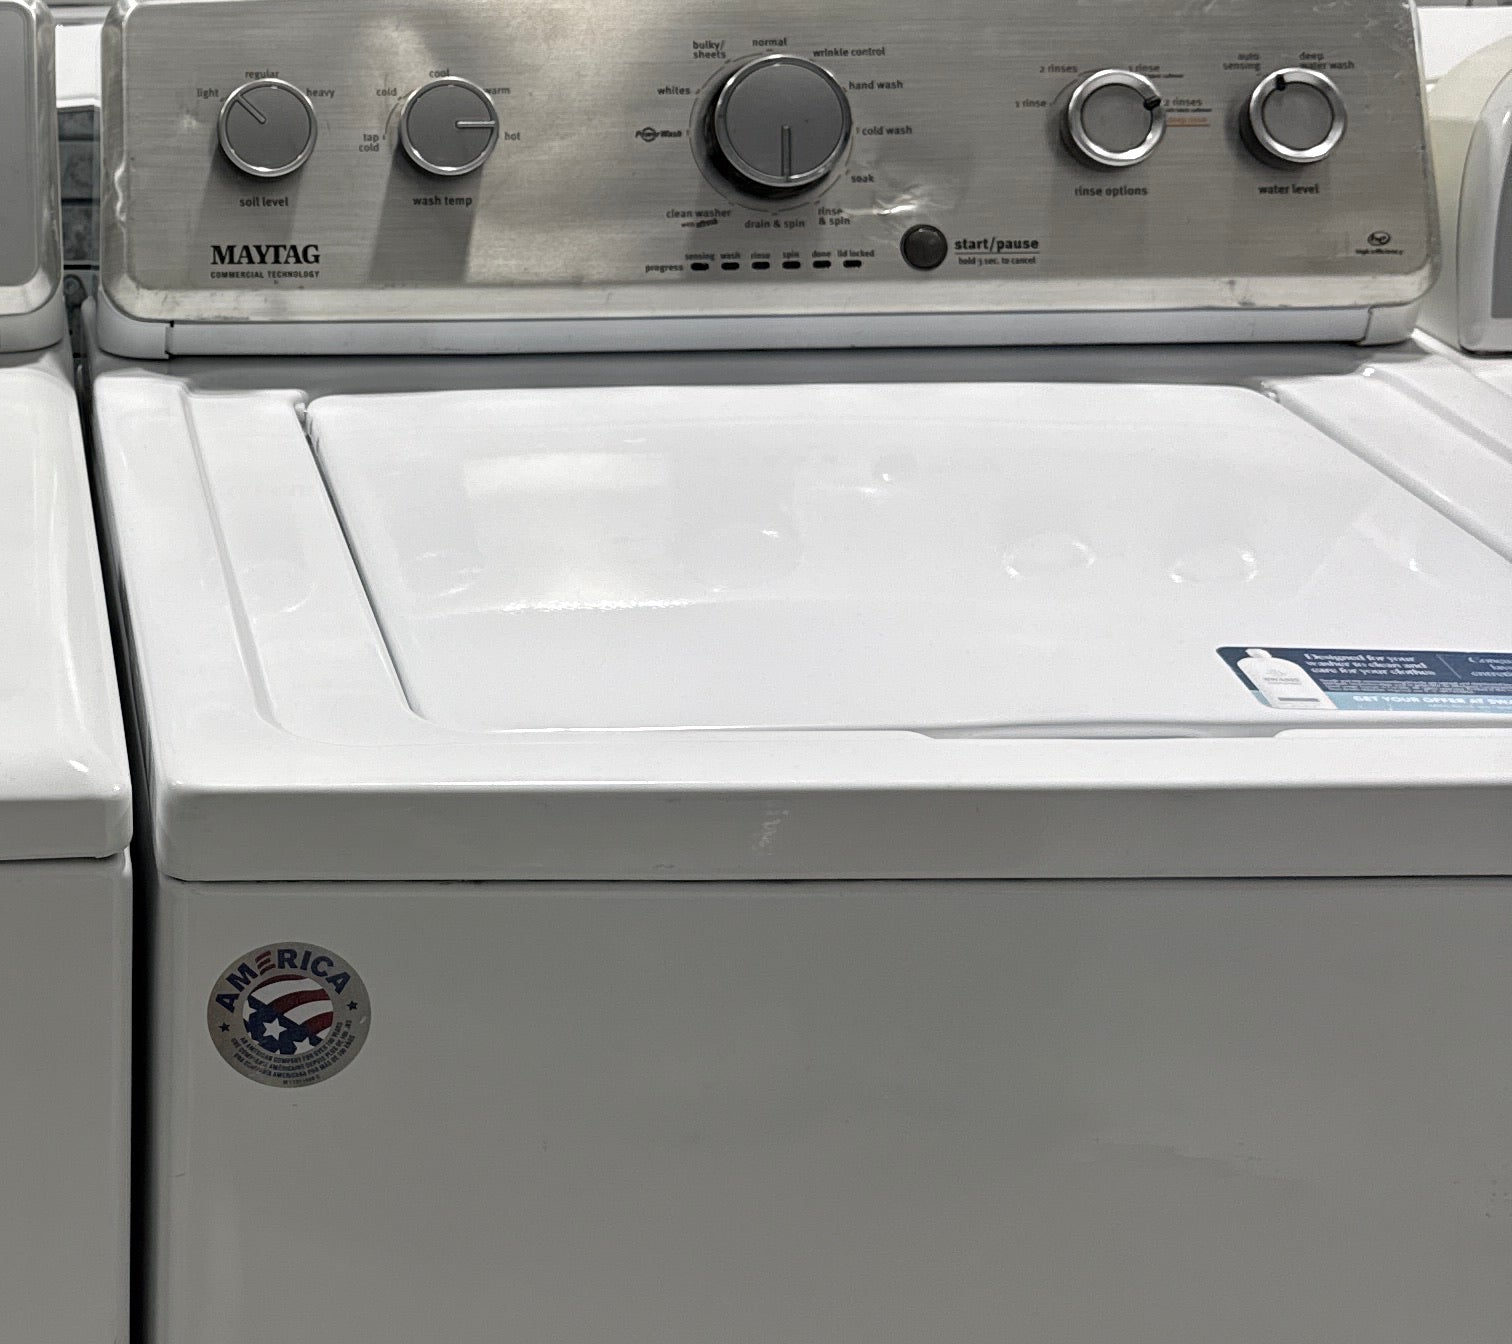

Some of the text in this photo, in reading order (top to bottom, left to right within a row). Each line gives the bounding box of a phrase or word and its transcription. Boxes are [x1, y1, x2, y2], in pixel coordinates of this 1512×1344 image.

[692, 39, 725, 51] bulky/
[752, 37, 788, 47] normal
[692, 50, 727, 60] sheets
[813, 46, 886, 57] wrinkle control
[1237, 52, 1260, 61] auto
[1298, 51, 1325, 61] deep
[1047, 64, 1078, 73] rinses
[1329, 60, 1355, 69] wash
[244, 69, 280, 79] regular
[428, 69, 451, 77] cool
[848, 79, 904, 90] hand wash
[196, 87, 220, 99] light
[305, 87, 335, 98] heavy
[375, 87, 398, 97] cold
[657, 85, 691, 95] whites
[1022, 98, 1047, 107] rinse
[1172, 97, 1203, 107] rinses
[861, 125, 913, 136] cold wash
[363, 133, 380, 143] tap
[504, 131, 521, 141] hot
[358, 143, 380, 153] cold
[850, 174, 874, 183] soak
[1074, 185, 1148, 197] rinse options
[1258, 183, 1320, 194] water level
[239, 196, 289, 207] soil level
[412, 195, 473, 207] wash temp
[666, 208, 731, 218] clean washer
[817, 206, 843, 216] rinse
[744, 218, 770, 229] drain
[783, 218, 805, 230] spin
[828, 216, 851, 227] spin
[954, 237, 1039, 253] start/pause
[210, 244, 321, 265] MAYTAG
[958, 256, 976, 265] hold
[1010, 256, 1036, 265] cancel
[645, 264, 684, 273] progress
[210, 270, 320, 279] COMMERCIAL TECHNOLOGY
[216, 948, 352, 1014] AMERICA
